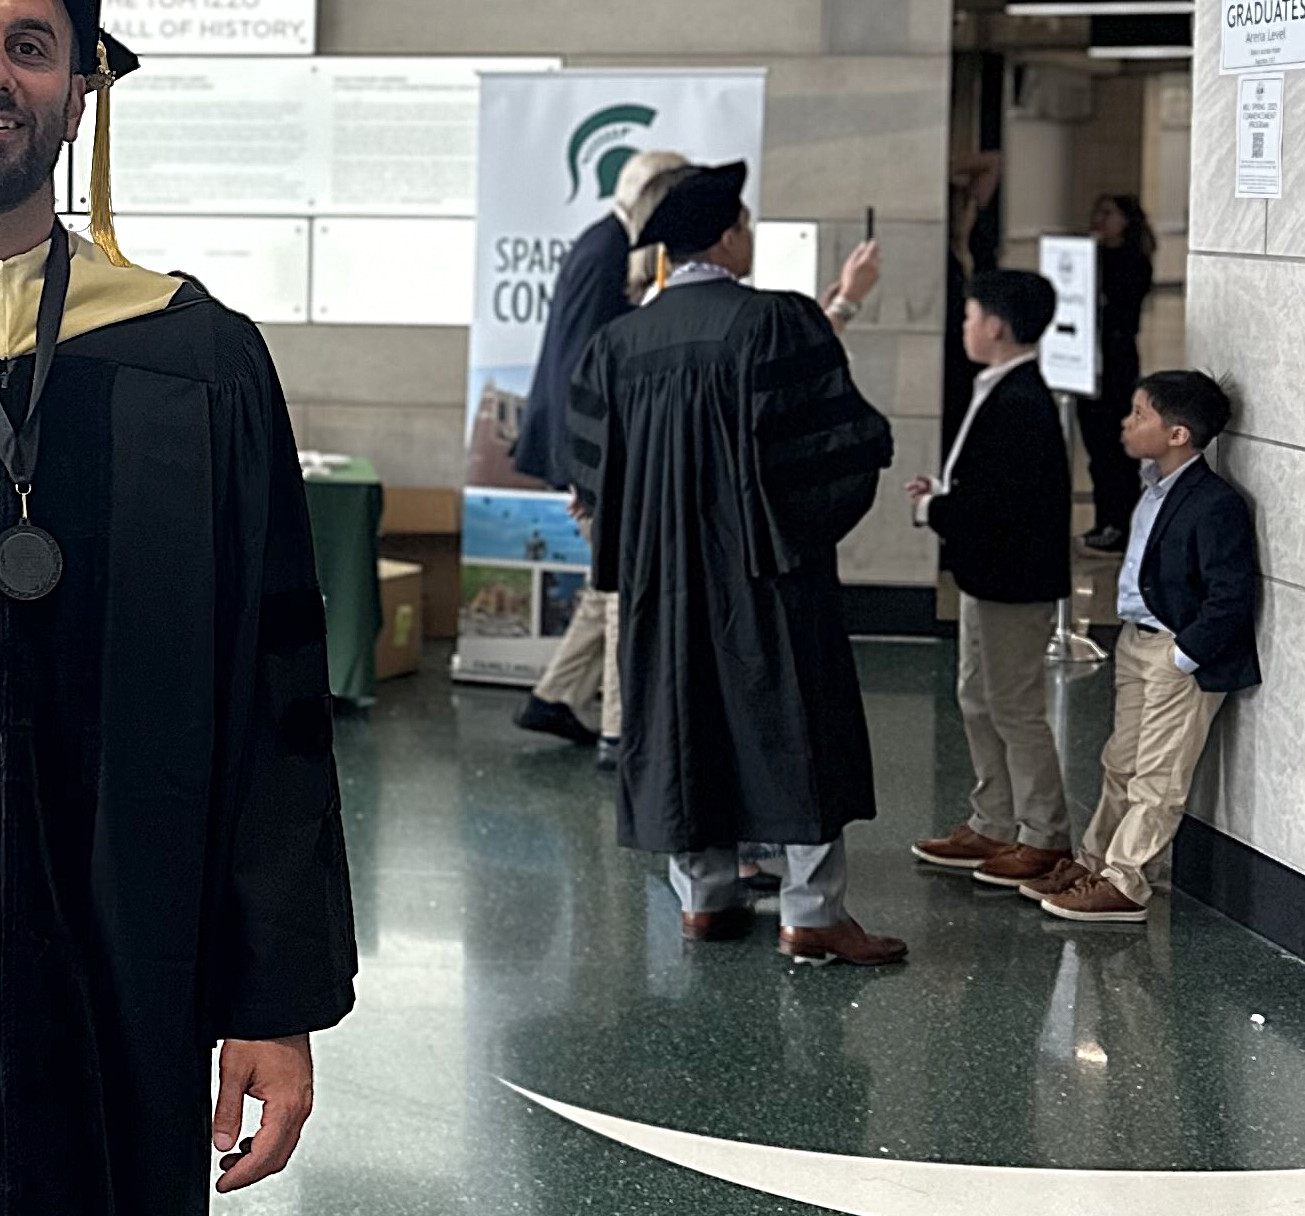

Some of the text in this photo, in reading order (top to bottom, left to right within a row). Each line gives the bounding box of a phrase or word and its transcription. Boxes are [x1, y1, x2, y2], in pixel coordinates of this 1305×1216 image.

[101, 19, 304, 40] ALL OF HISTORY
[1268, 26, 1286, 42] Level
[495, 237, 576, 273] SPAR
